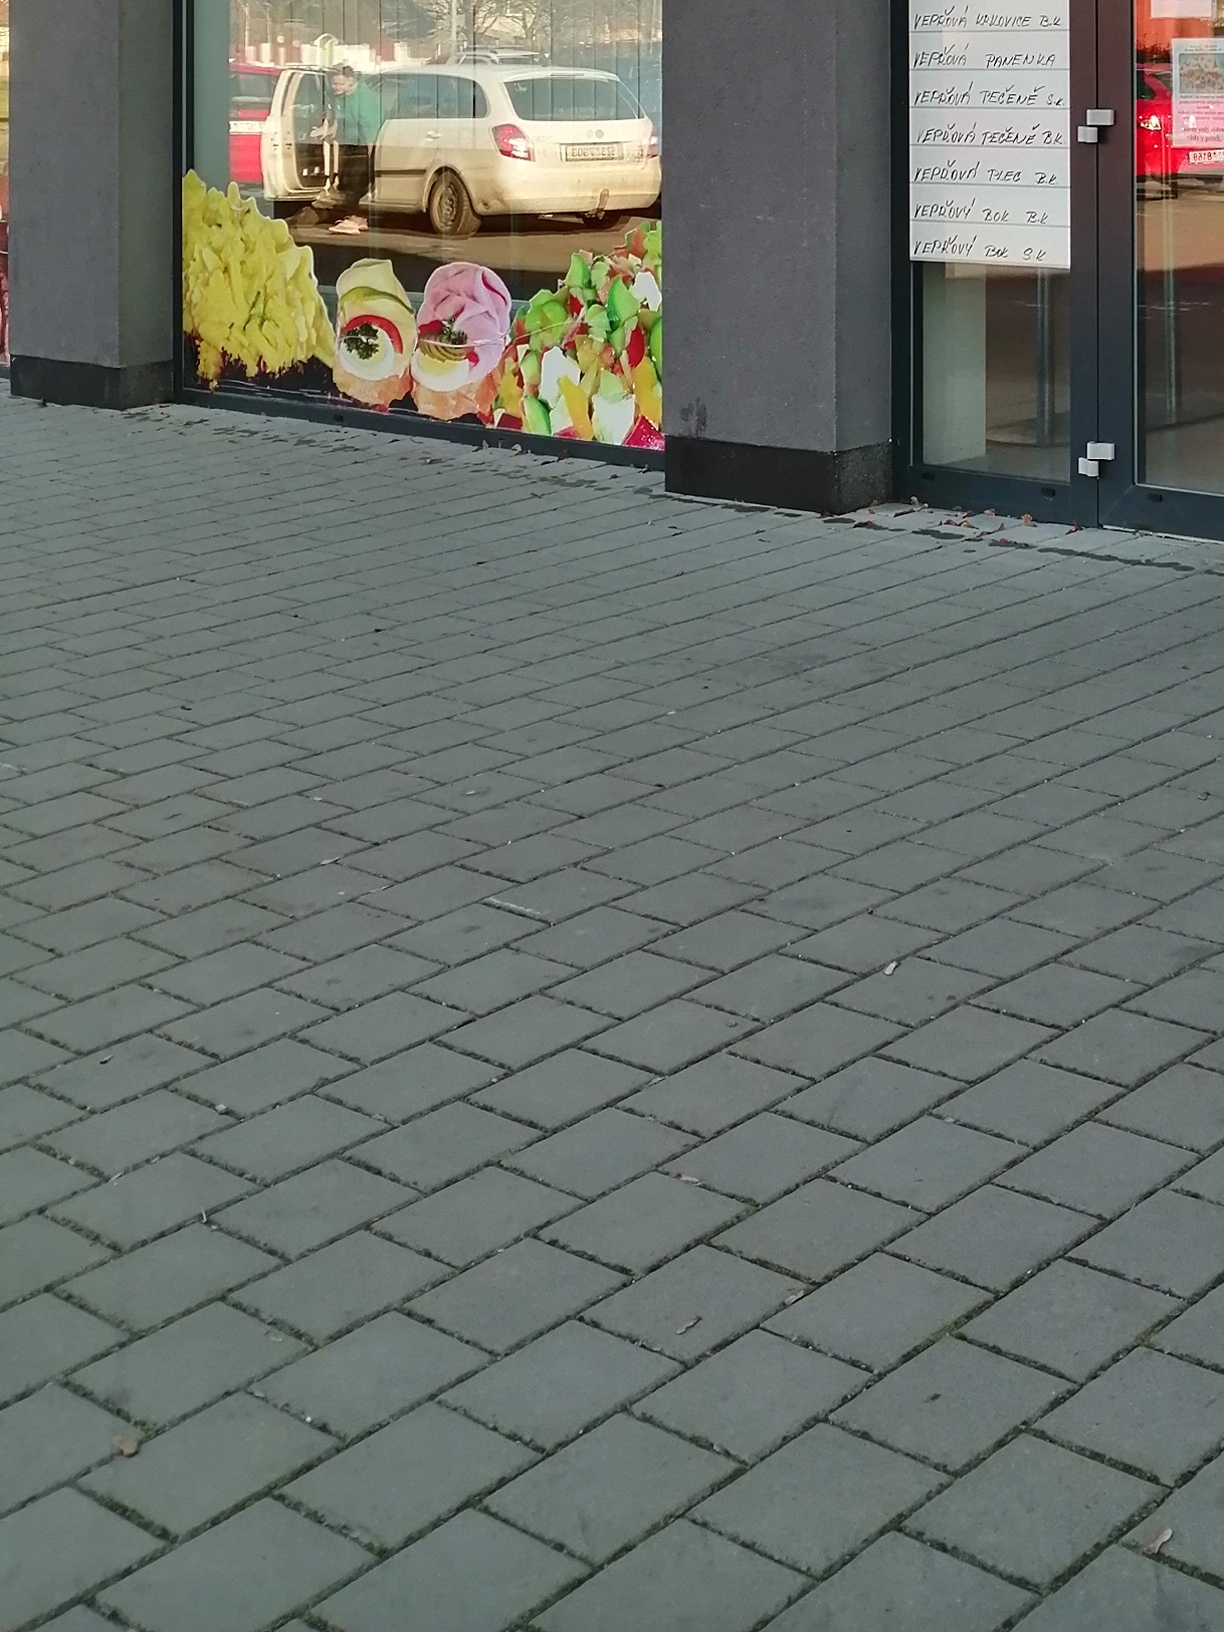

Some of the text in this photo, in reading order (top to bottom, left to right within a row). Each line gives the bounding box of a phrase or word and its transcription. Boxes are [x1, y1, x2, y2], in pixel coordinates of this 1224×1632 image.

[914, 5, 969, 29] VEPŘOVÁ
[913, 43, 1056, 68] VEPŘOVÁ PANENKA
[914, 81, 973, 106] VEPŘOVÁ
[980, 85, 1045, 105] PEČENĚ
[916, 122, 977, 143] VEPŘOVÁ
[981, 123, 1040, 145] PEČENĚ
[914, 159, 980, 182] VEPŘOVÁ
[987, 168, 1021, 182] PLEC
[914, 197, 976, 220] VEPŘOVÝ
[982, 208, 1010, 222] BOK
[913, 235, 978, 257] VEPŘOVÝ
[984, 244, 1009, 258] BOK
